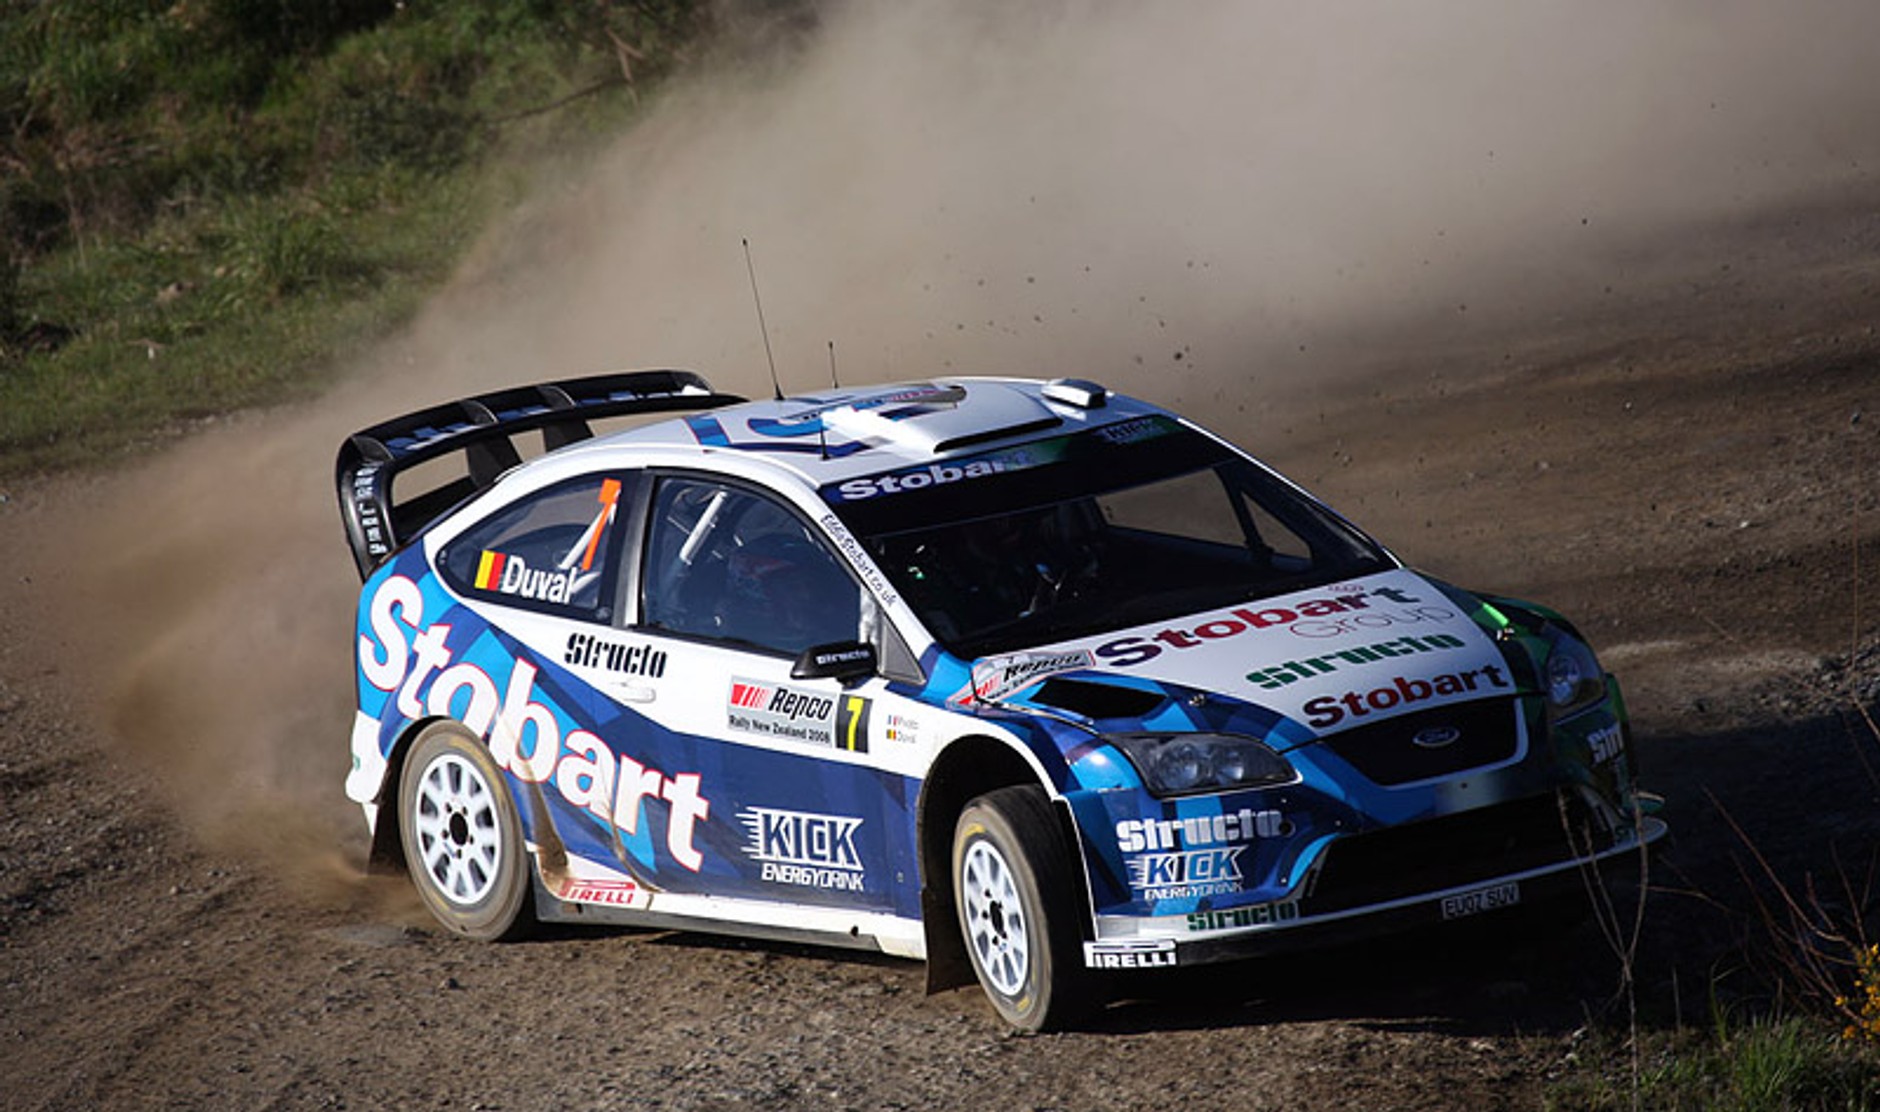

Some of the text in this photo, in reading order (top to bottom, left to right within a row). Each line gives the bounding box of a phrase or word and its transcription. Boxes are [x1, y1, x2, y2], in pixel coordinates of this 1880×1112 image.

[840, 450, 1034, 501] Stobart
[501, 557, 576, 604] Duval
[1096, 584, 1421, 668] Stobart
[1290, 607, 1456, 638] Group
[768, 687, 834, 720] Repco
[1303, 664, 1510, 728] Stobart
[358, 575, 709, 872] Stobart
[728, 713, 831, 745] Rally New Zealand 2008
[846, 697, 864, 751] 7
[756, 810, 863, 870] KICK
[1143, 846, 1246, 887] KICK
[559, 878, 636, 905] PIRELLI
[1083, 938, 1177, 968] PIRELLI
